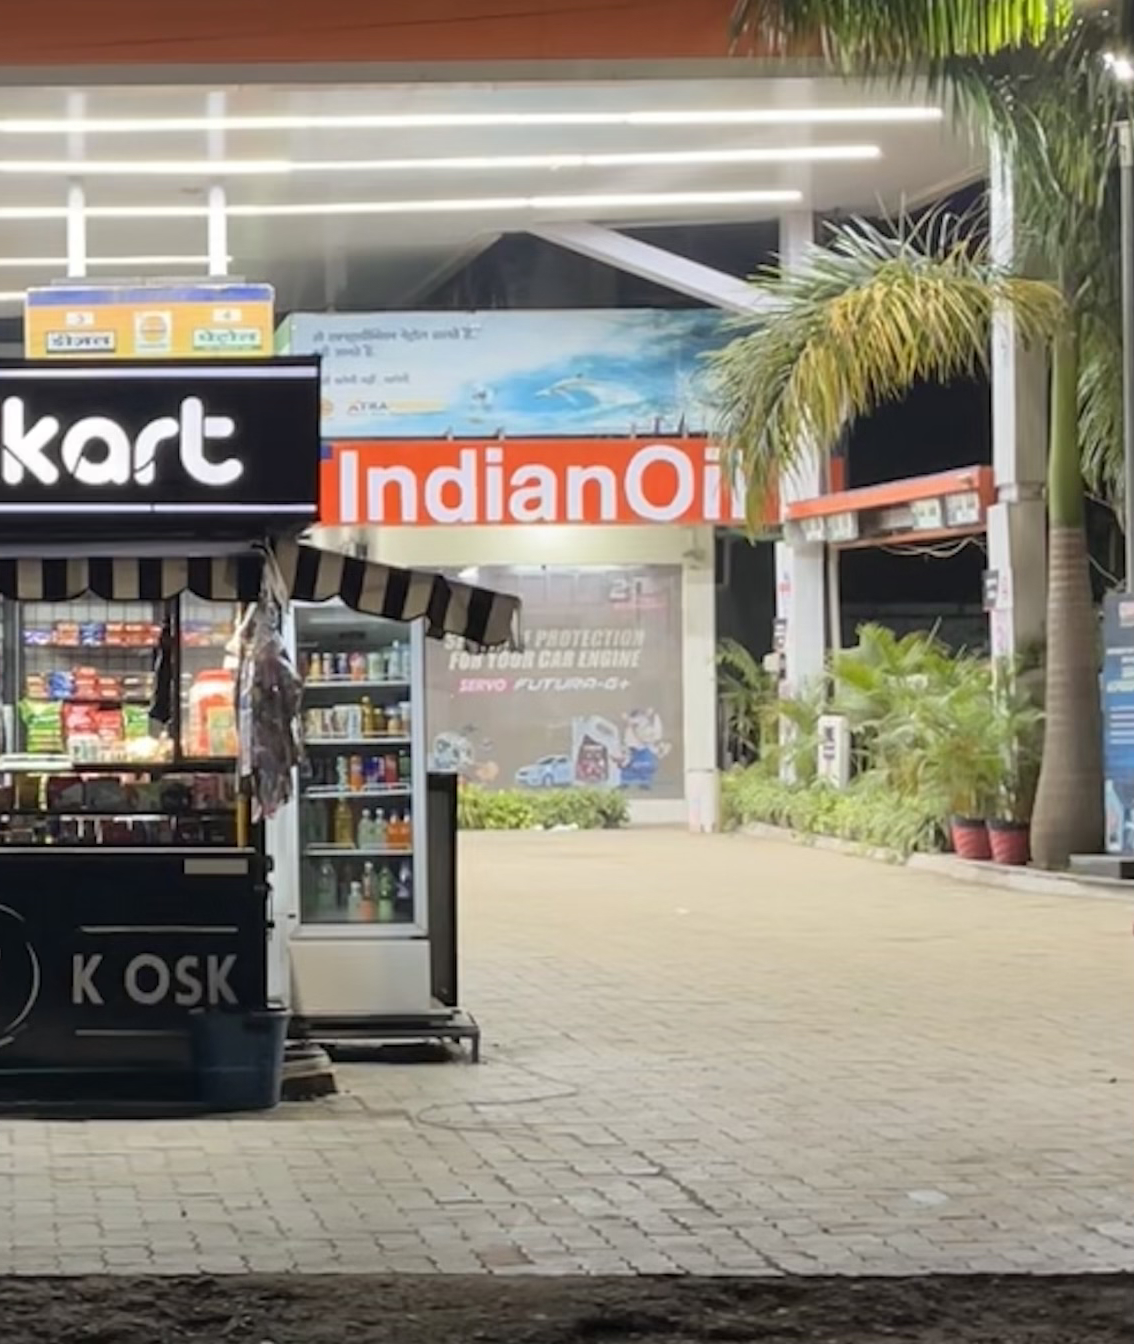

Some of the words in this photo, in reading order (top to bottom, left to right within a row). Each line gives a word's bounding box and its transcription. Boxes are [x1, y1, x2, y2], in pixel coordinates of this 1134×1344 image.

[535, 629, 645, 648] PROTECTION
[448, 650, 484, 670] FOR
[488, 649, 535, 669] YOUR
[537, 649, 575, 669] CAR
[577, 649, 641, 669] ENGINE
[459, 678, 507, 692] SERVO
